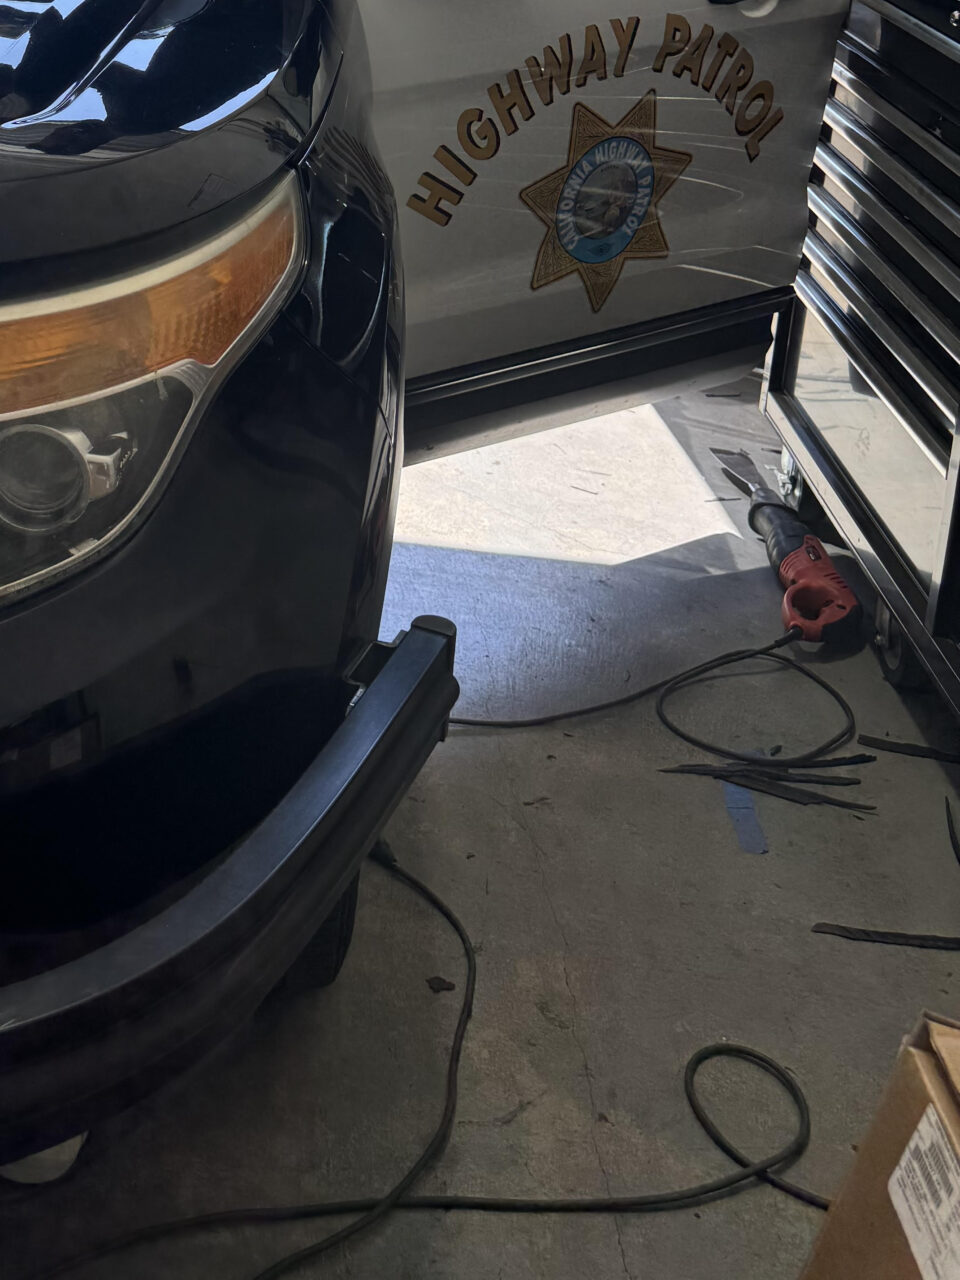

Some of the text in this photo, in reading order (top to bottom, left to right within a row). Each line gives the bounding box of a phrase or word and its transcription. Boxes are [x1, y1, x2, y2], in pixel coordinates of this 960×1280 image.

[406, 13, 784, 227] HIGHWAY PATROL
[595, 141, 650, 173] HIGHWAY
[624, 176, 652, 236] PATROL
